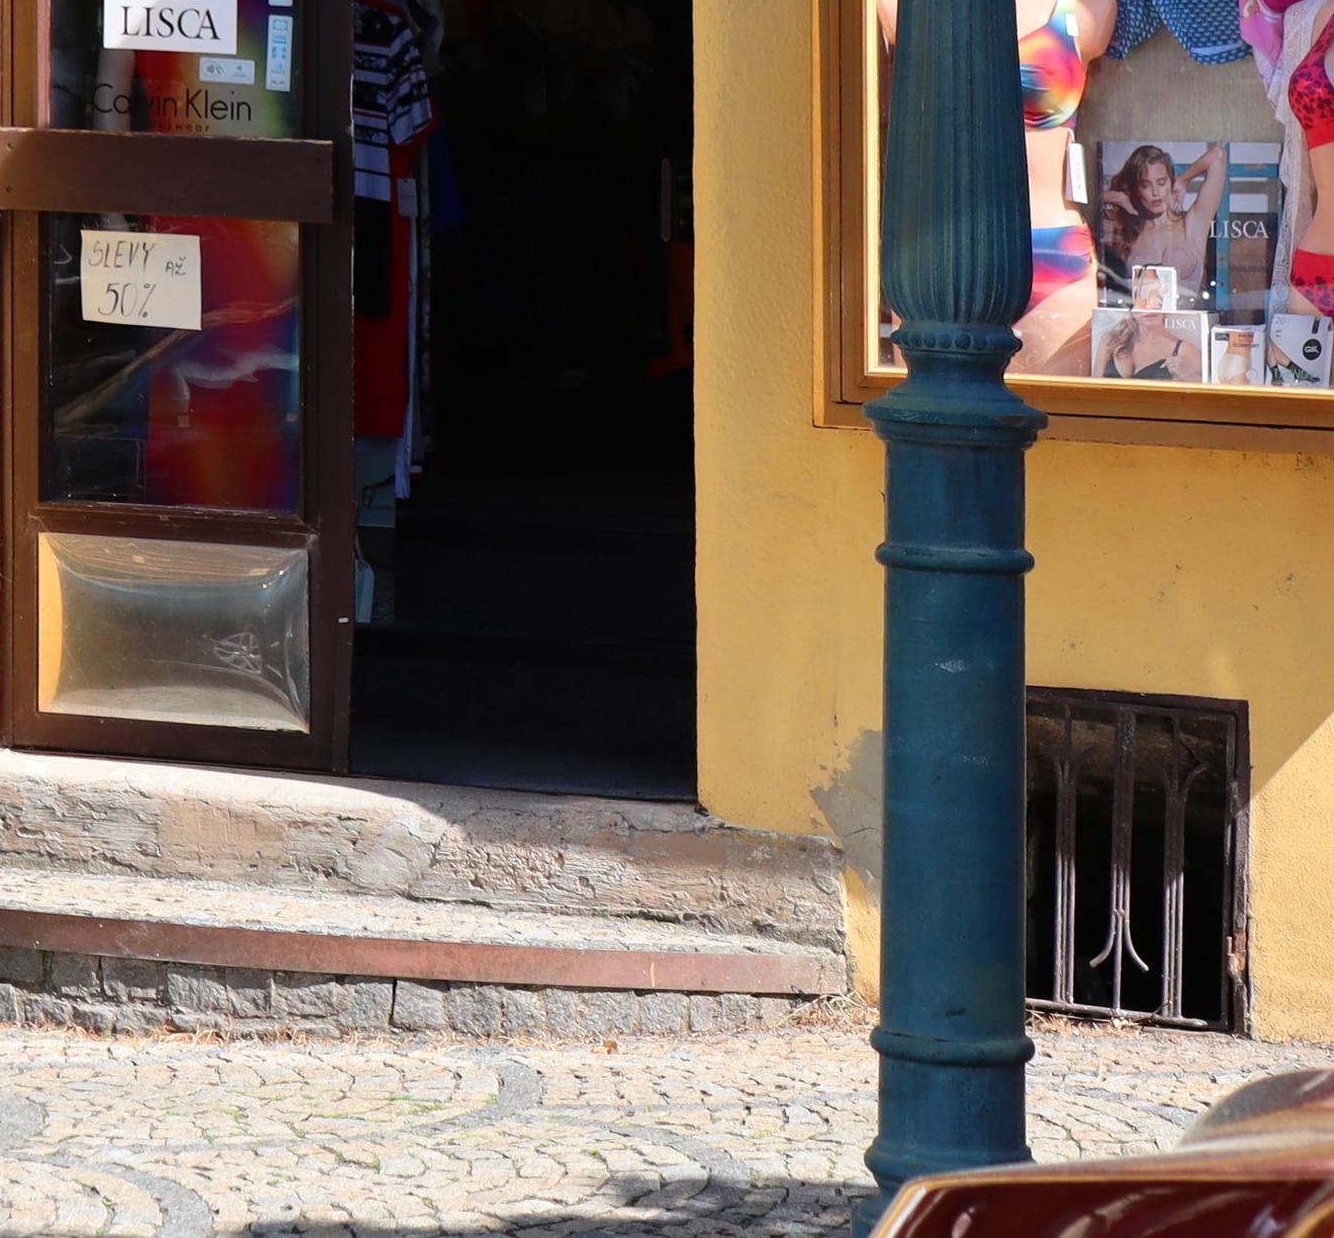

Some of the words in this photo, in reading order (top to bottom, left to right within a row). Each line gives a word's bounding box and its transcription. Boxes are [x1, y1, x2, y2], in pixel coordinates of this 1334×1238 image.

[121, 5, 221, 41] LISCA
[92, 82, 178, 118] Cavin
[185, 88, 252, 122] Klein
[1210, 220, 1269, 239] LISCA
[88, 240, 156, 272] SLEVY
[165, 256, 187, 277] AŽ
[98, 282, 156, 318] 50%
[1165, 318, 1197, 330] LISCA
